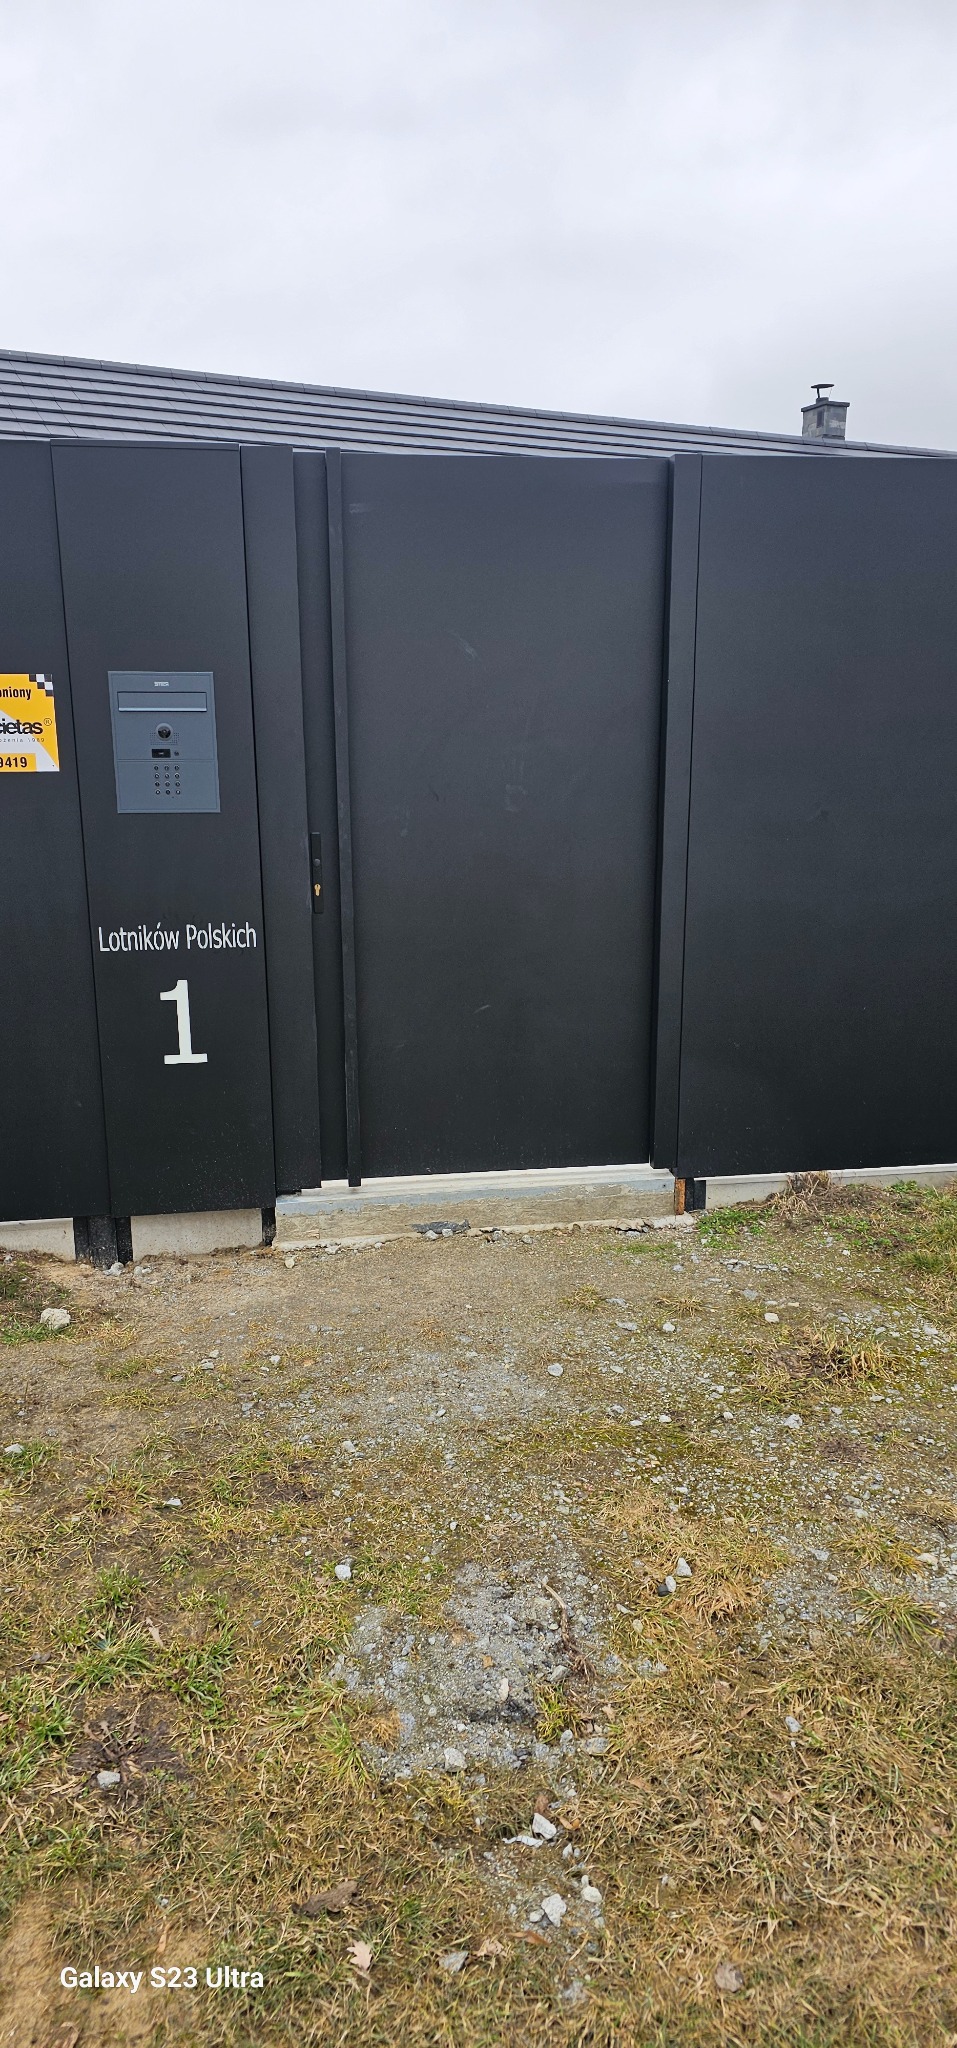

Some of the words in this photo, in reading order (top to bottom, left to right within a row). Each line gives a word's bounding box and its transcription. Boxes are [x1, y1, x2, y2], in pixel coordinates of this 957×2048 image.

[0, 686, 31, 700] niony
[98, 922, 179, 951] Lotników
[186, 922, 257, 949] Polskich
[160, 980, 208, 1065] 1
